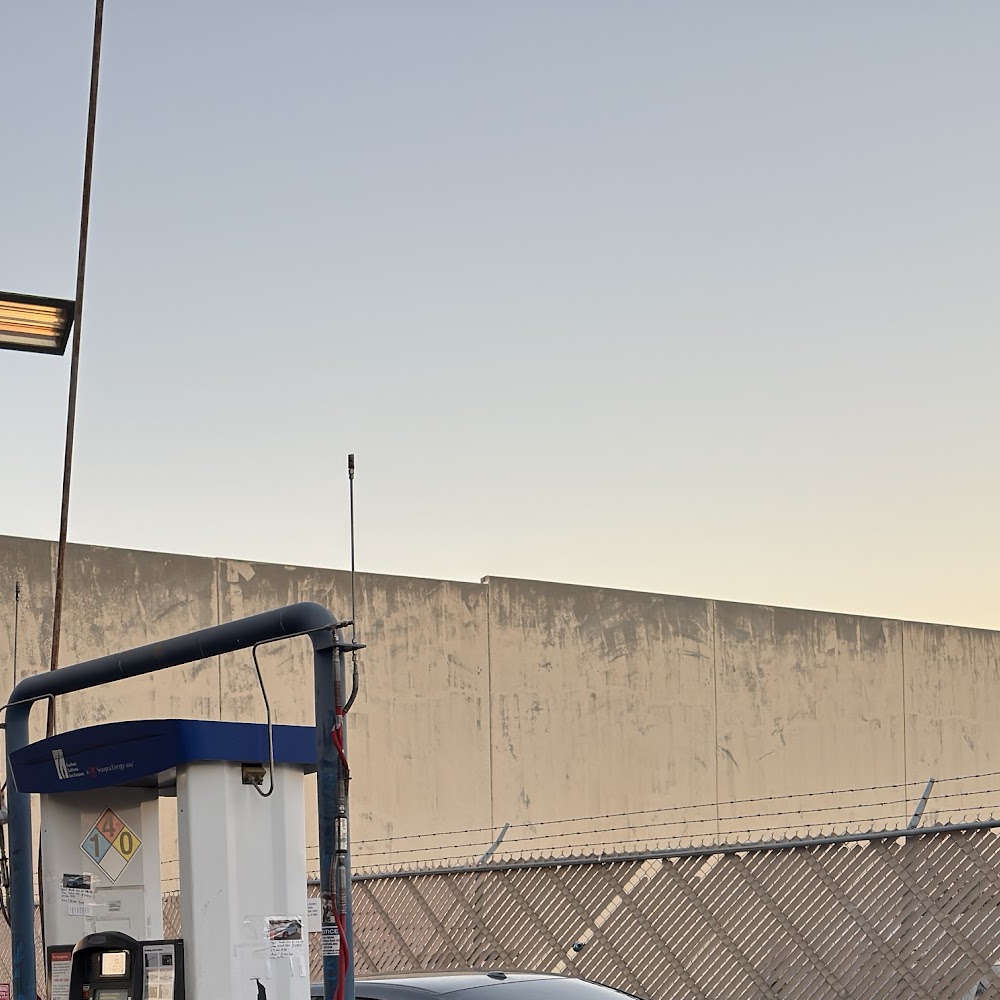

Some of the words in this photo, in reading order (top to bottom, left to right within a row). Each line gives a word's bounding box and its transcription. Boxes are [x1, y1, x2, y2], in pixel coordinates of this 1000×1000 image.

[102, 816, 115, 837] 4
[90, 834, 100, 857] 1
[120, 831, 133, 855] 0
